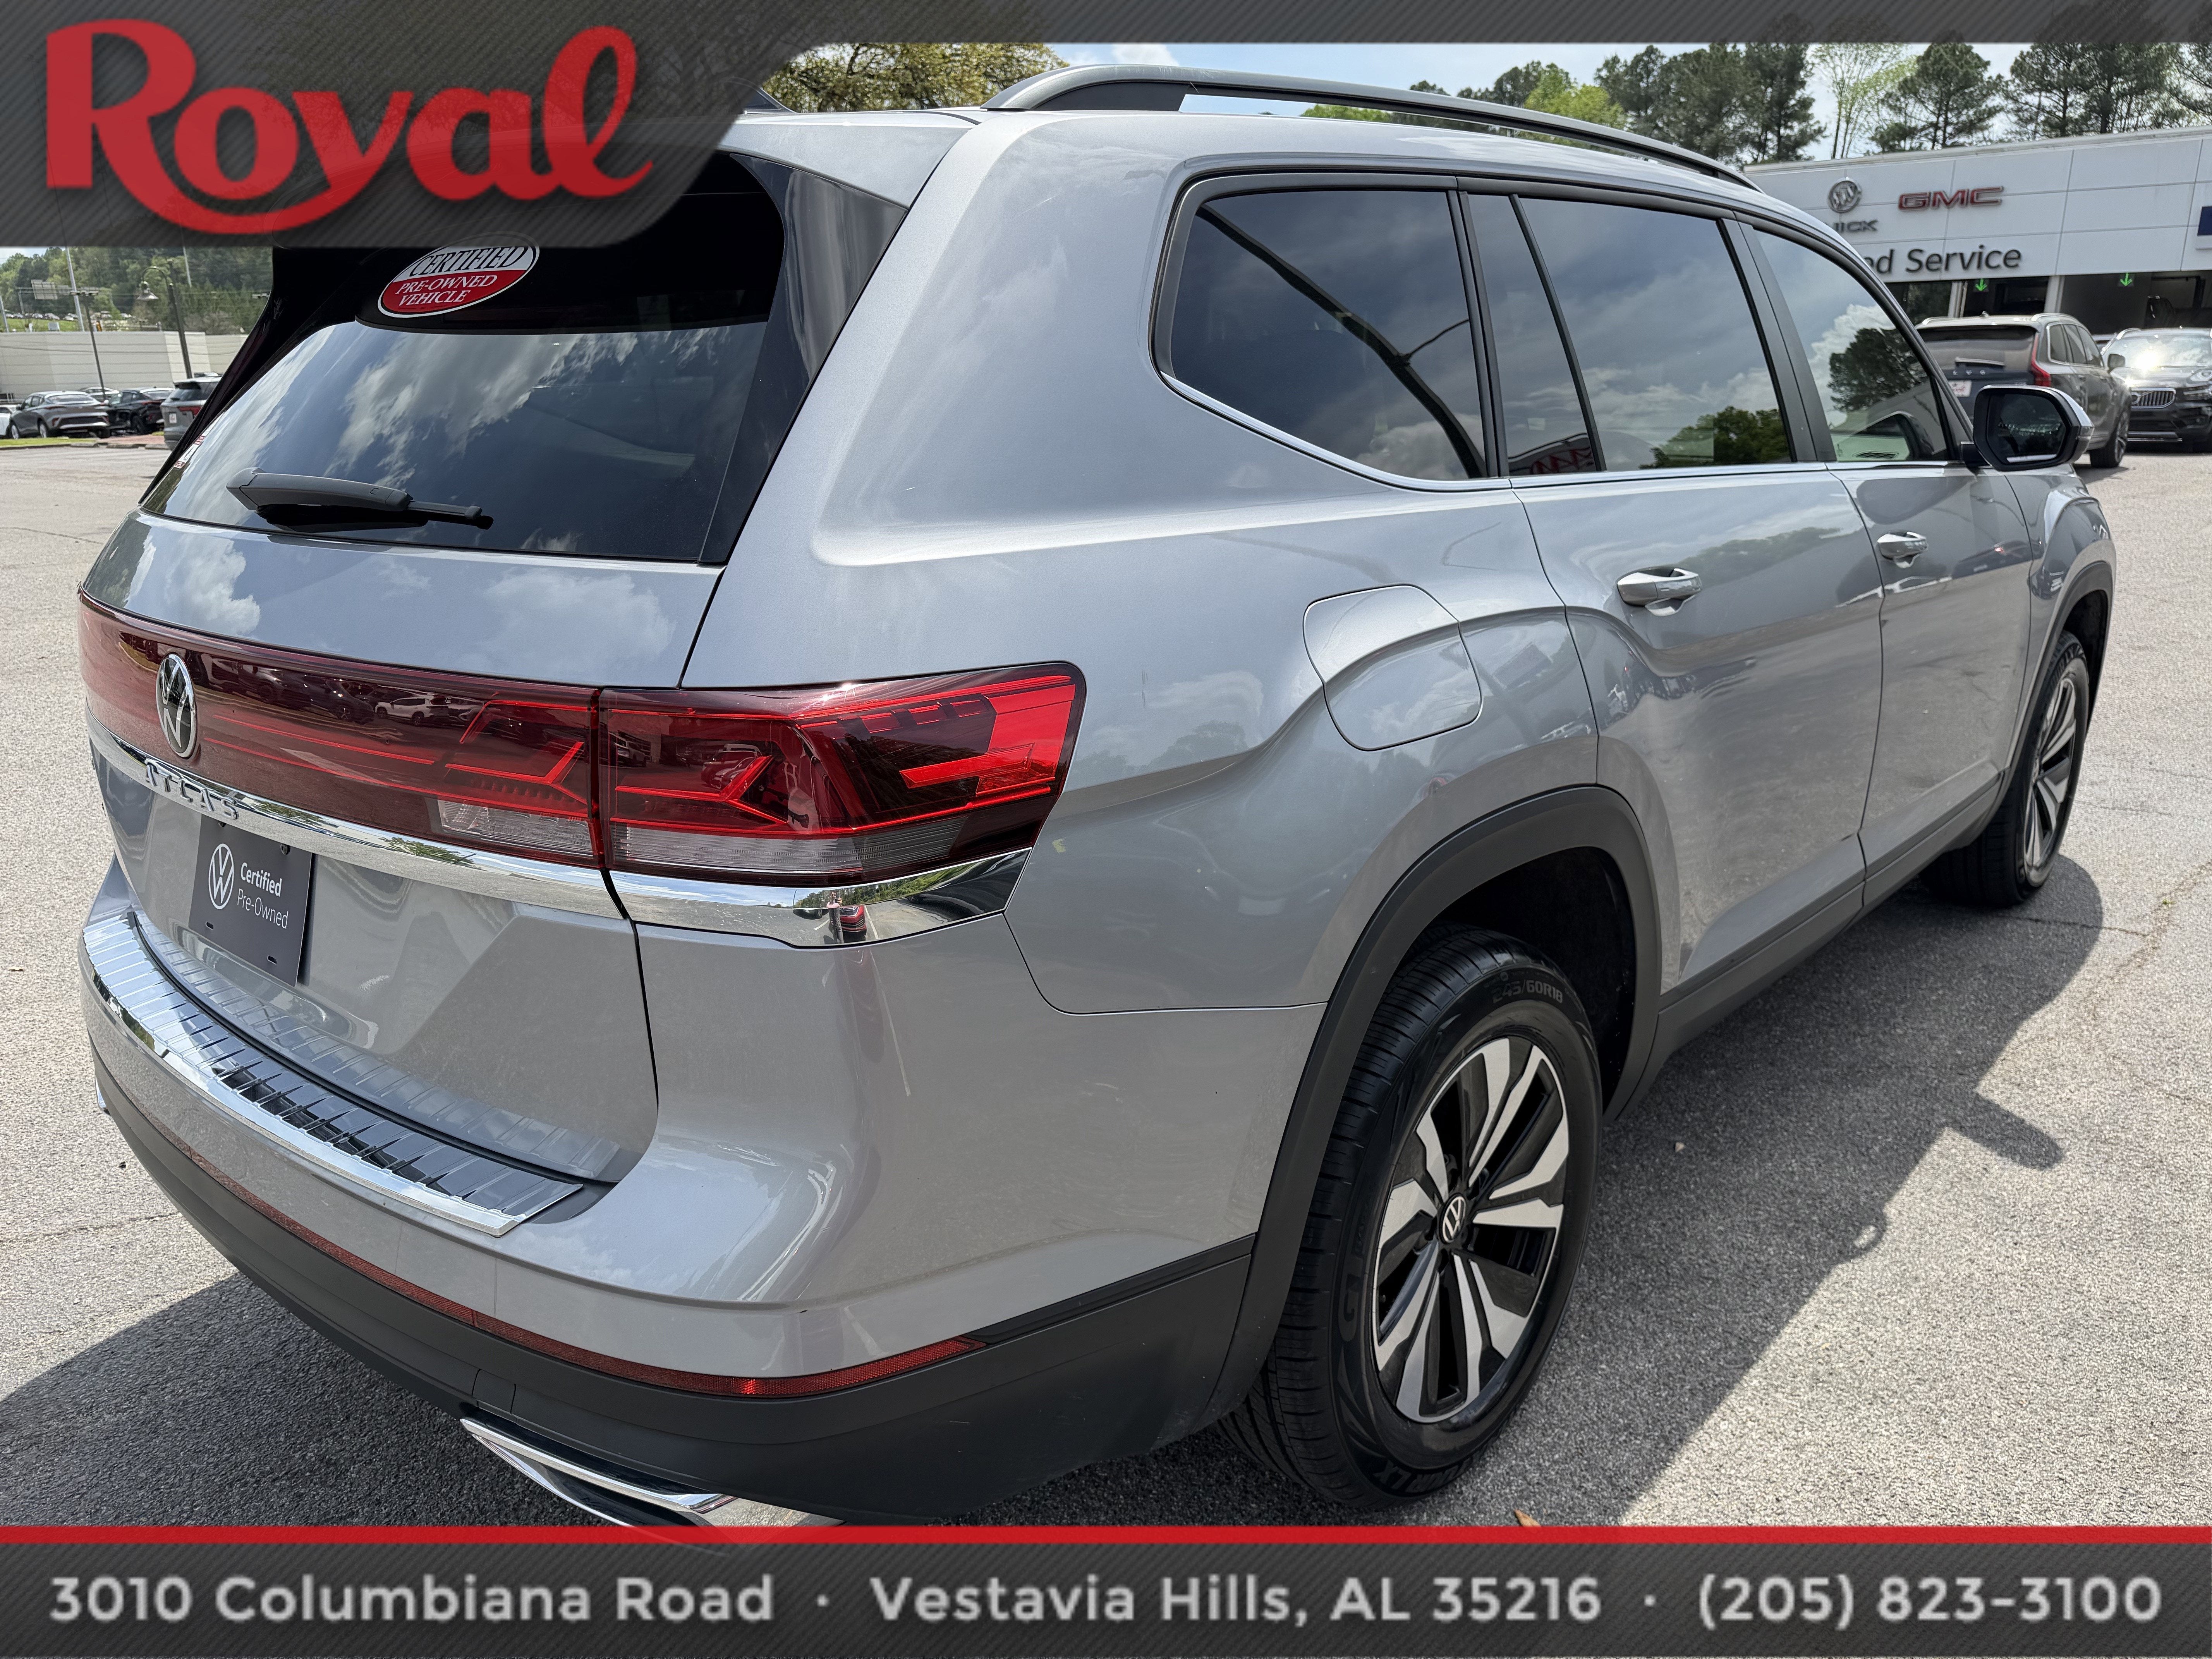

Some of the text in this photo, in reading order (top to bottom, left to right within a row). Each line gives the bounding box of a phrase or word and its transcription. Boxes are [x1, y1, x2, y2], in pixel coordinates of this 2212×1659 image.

[1898, 186, 2004, 211] GMC
[409, 246, 528, 277] CERTIFIED
[1905, 244, 2022, 272] Service
[395, 275, 498, 295] PRE-OWNED
[398, 290, 471, 306] VEHICLE
[240, 862, 282, 897] Certified
[237, 888, 289, 929] Pre-Owned
[1492, 979, 1563, 1004] 245/60R18
